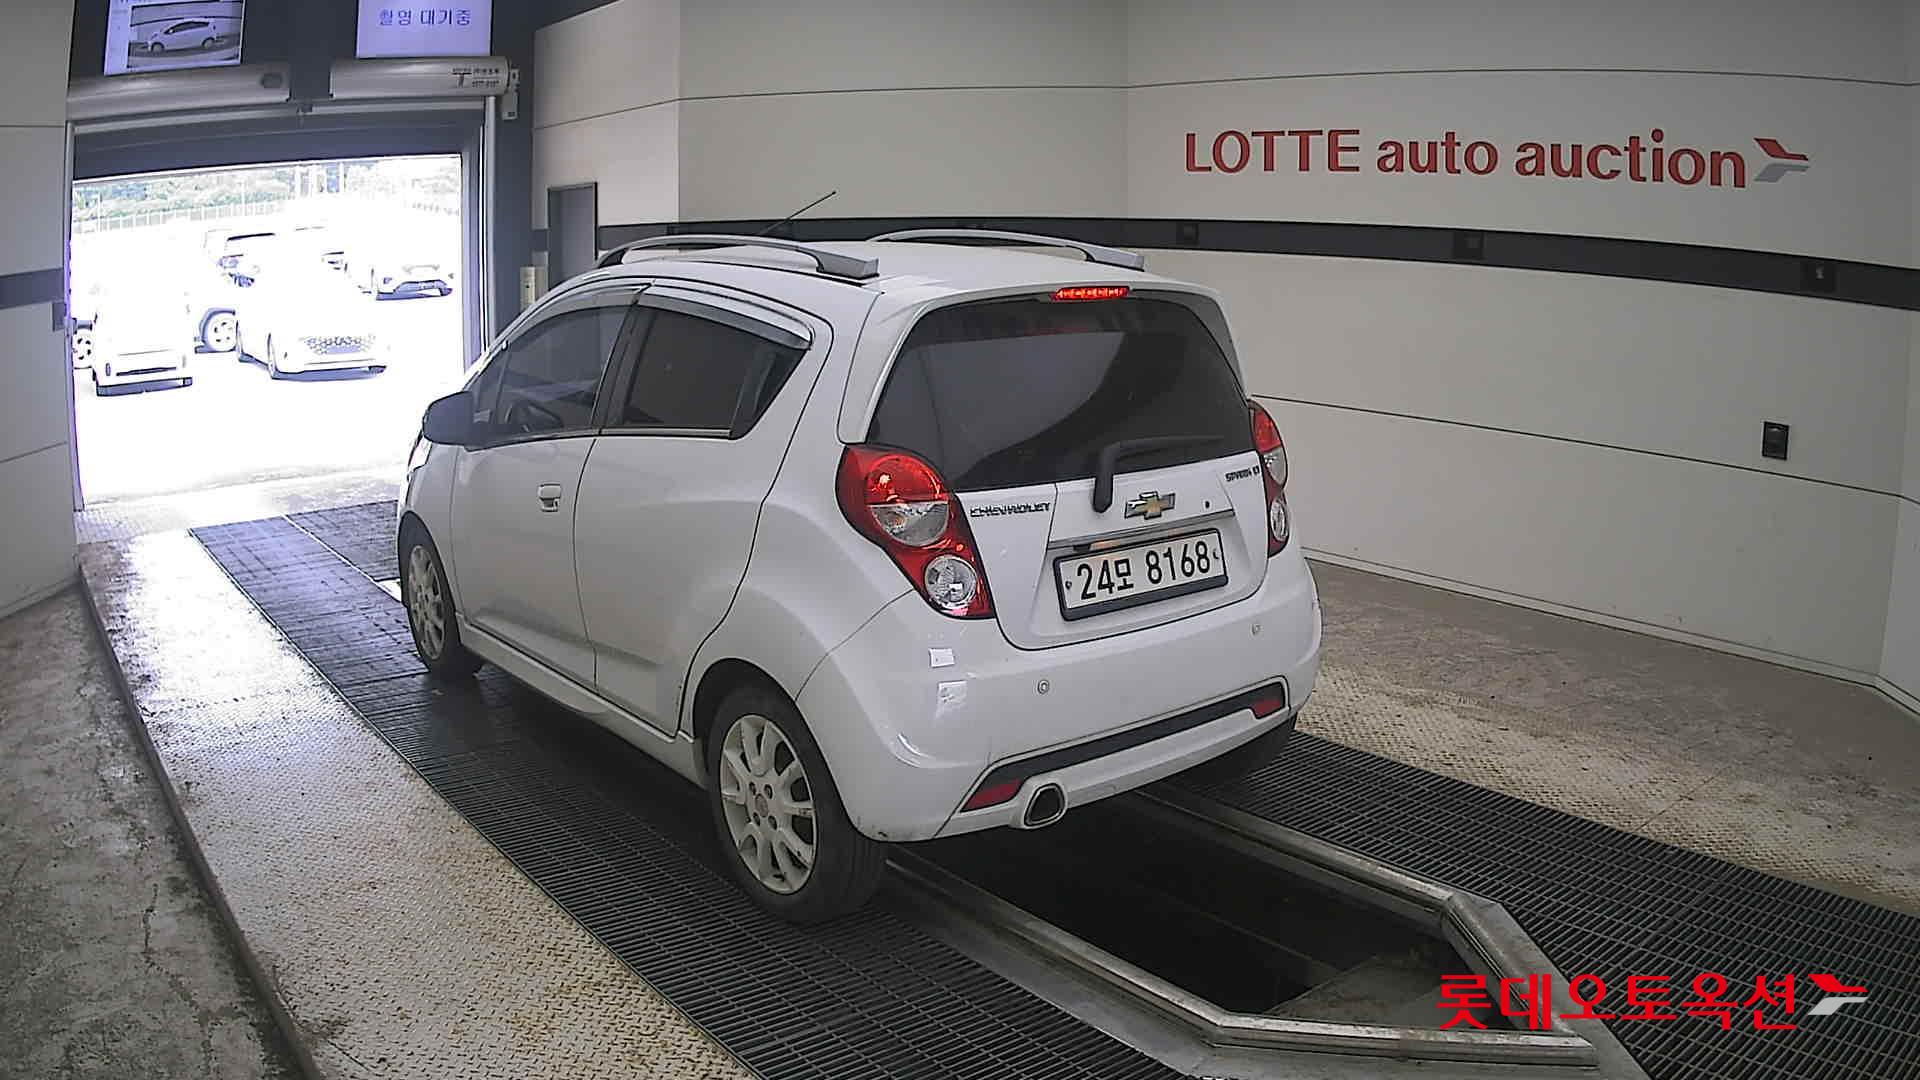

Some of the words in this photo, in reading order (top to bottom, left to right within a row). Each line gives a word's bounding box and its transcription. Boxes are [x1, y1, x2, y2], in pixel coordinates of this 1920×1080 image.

[420, 9, 470, 25] 대기중
[1186, 129, 1360, 172] LOTTE
[1377, 131, 1498, 174] auto
[1515, 128, 1746, 187] auction
[1077, 559, 1134, 600] 24모
[1145, 541, 1210, 584] 8168
